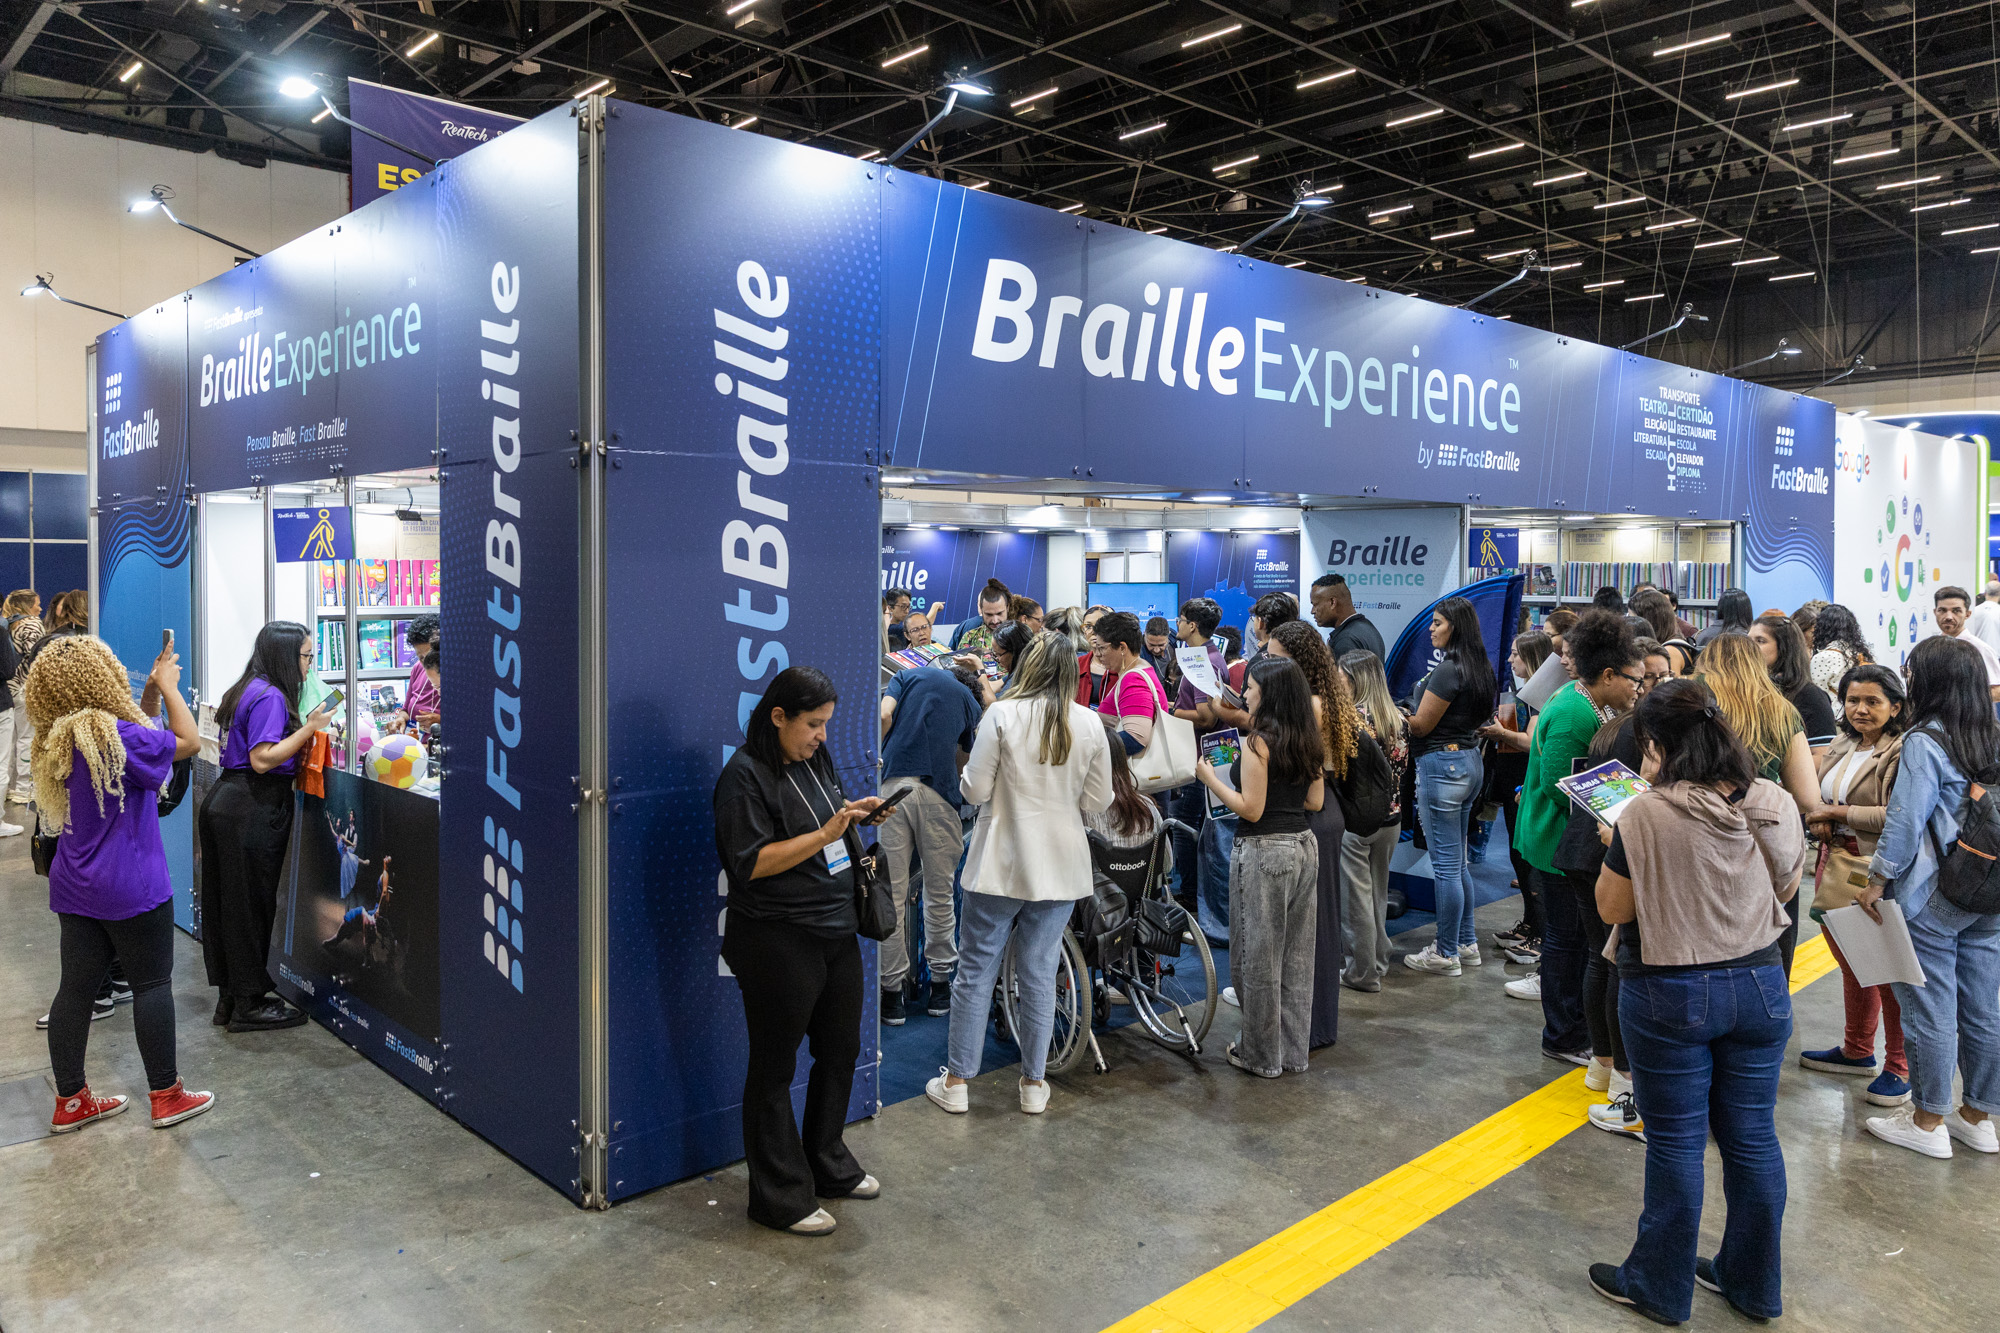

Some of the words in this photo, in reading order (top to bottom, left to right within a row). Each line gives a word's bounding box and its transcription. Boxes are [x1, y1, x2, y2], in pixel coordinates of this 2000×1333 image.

[441, 120, 489, 143] ReaTech
[1639, 396, 1668, 416] TEATRO
[1659, 386, 1700, 406] TRANSPORTE
[1644, 417, 1668, 433] ELEIÇÃO
[1676, 405, 1714, 425] CERTIDÃO
[103, 408, 160, 460] FastBraille
[246, 435, 271, 452] Pensou
[272, 426, 297, 447] Braille,
[299, 424, 316, 443] Fast
[317, 417, 348, 441] Braille!
[1633, 431, 1667, 447] LITERATURA
[1676, 424, 1717, 441] RESTAURANTE
[1645, 448, 1667, 461] ESCADA
[1676, 439, 1697, 452] ESCOLA
[1417, 441, 1434, 469] by
[1459, 447, 1520, 472] FastBraille
[1676, 453, 1704, 466] ELEVADOR
[1676, 466, 1701, 478] DIPLOMA
[1771, 463, 1829, 495] FastBraille
[714, 260, 789, 767] stBraille
[480, 261, 522, 811] FastBraille
[1327, 535, 1428, 566] Braille
[1254, 561, 1289, 571] FastBraille
[1326, 569, 1425, 589] perience
[1362, 602, 1401, 610] FastBraille
[396, 1039, 434, 1075] FastBraille
